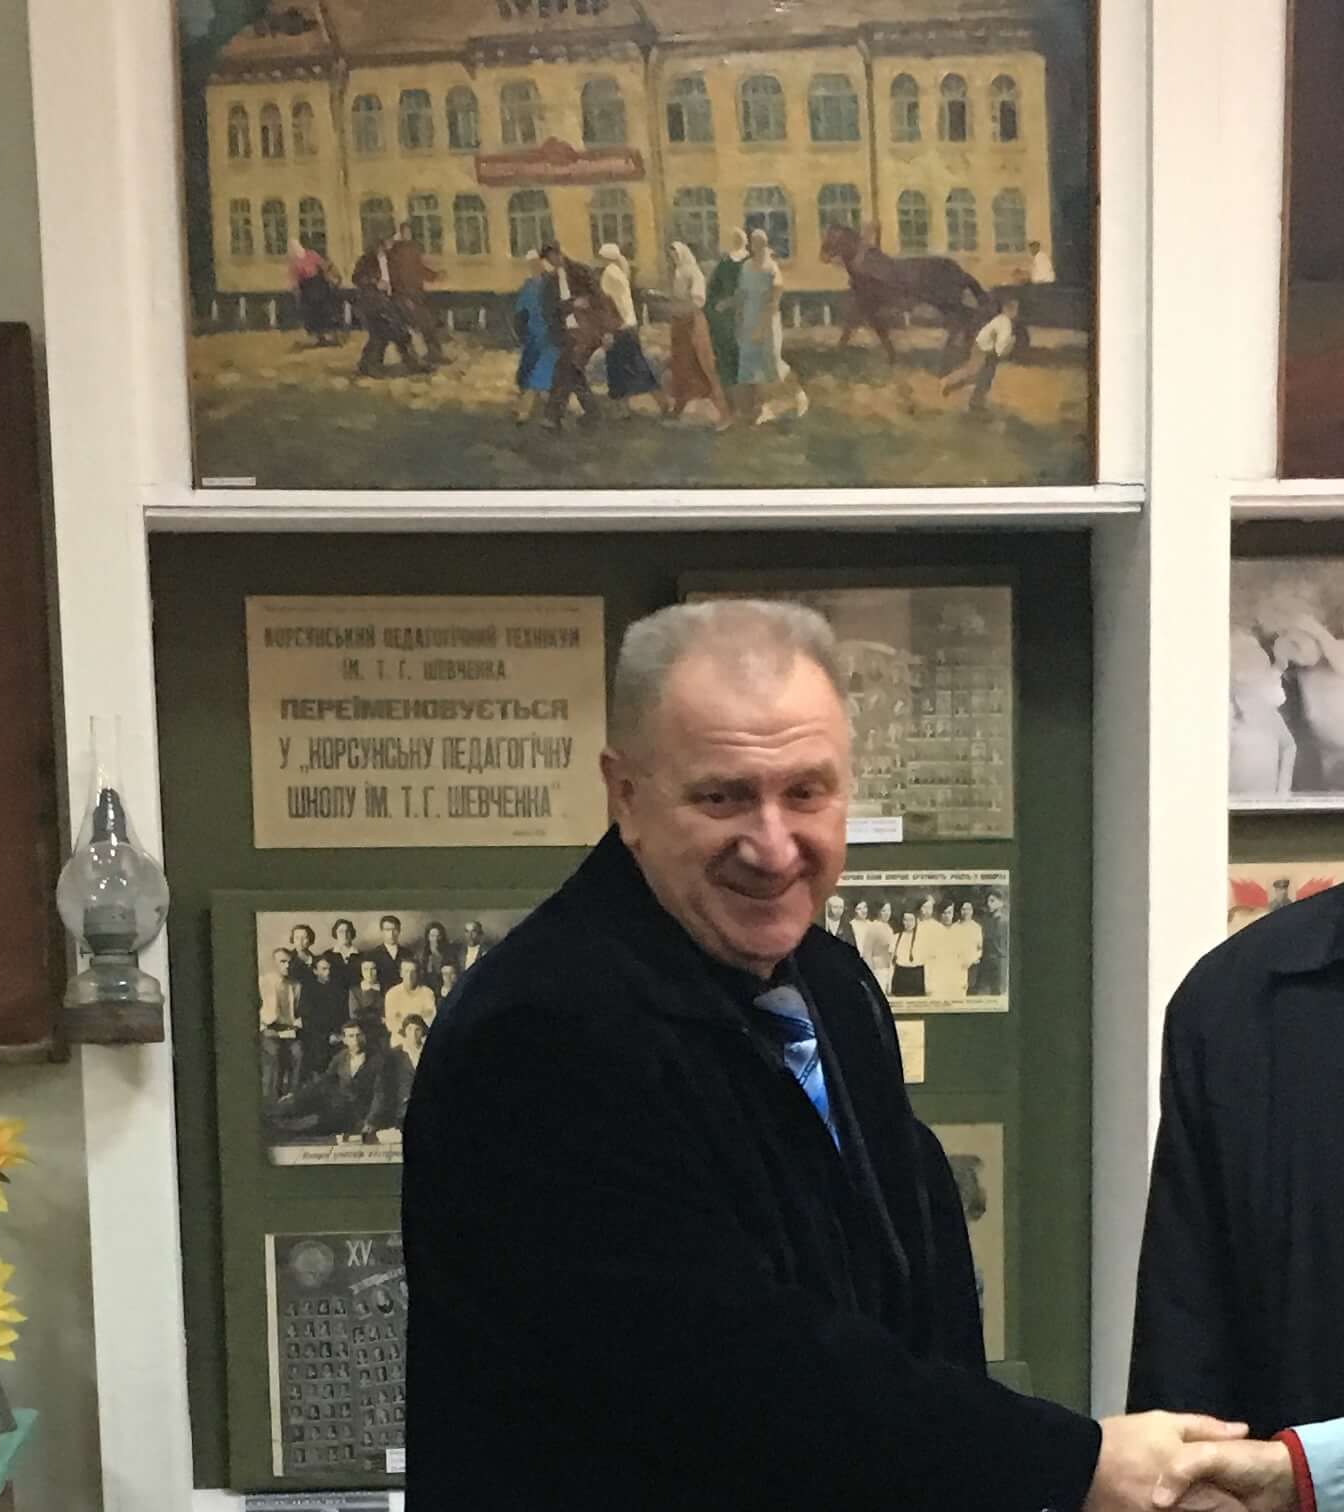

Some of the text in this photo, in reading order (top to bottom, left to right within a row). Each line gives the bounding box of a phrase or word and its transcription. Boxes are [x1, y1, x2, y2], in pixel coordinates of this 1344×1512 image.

[423, 659, 506, 681] ШЕВЧЕНКА
[279, 737, 291, 769] У
[442, 732, 573, 774] ПЕДАГОГІЧНУ
[287, 785, 356, 819] ШКОЛУ
